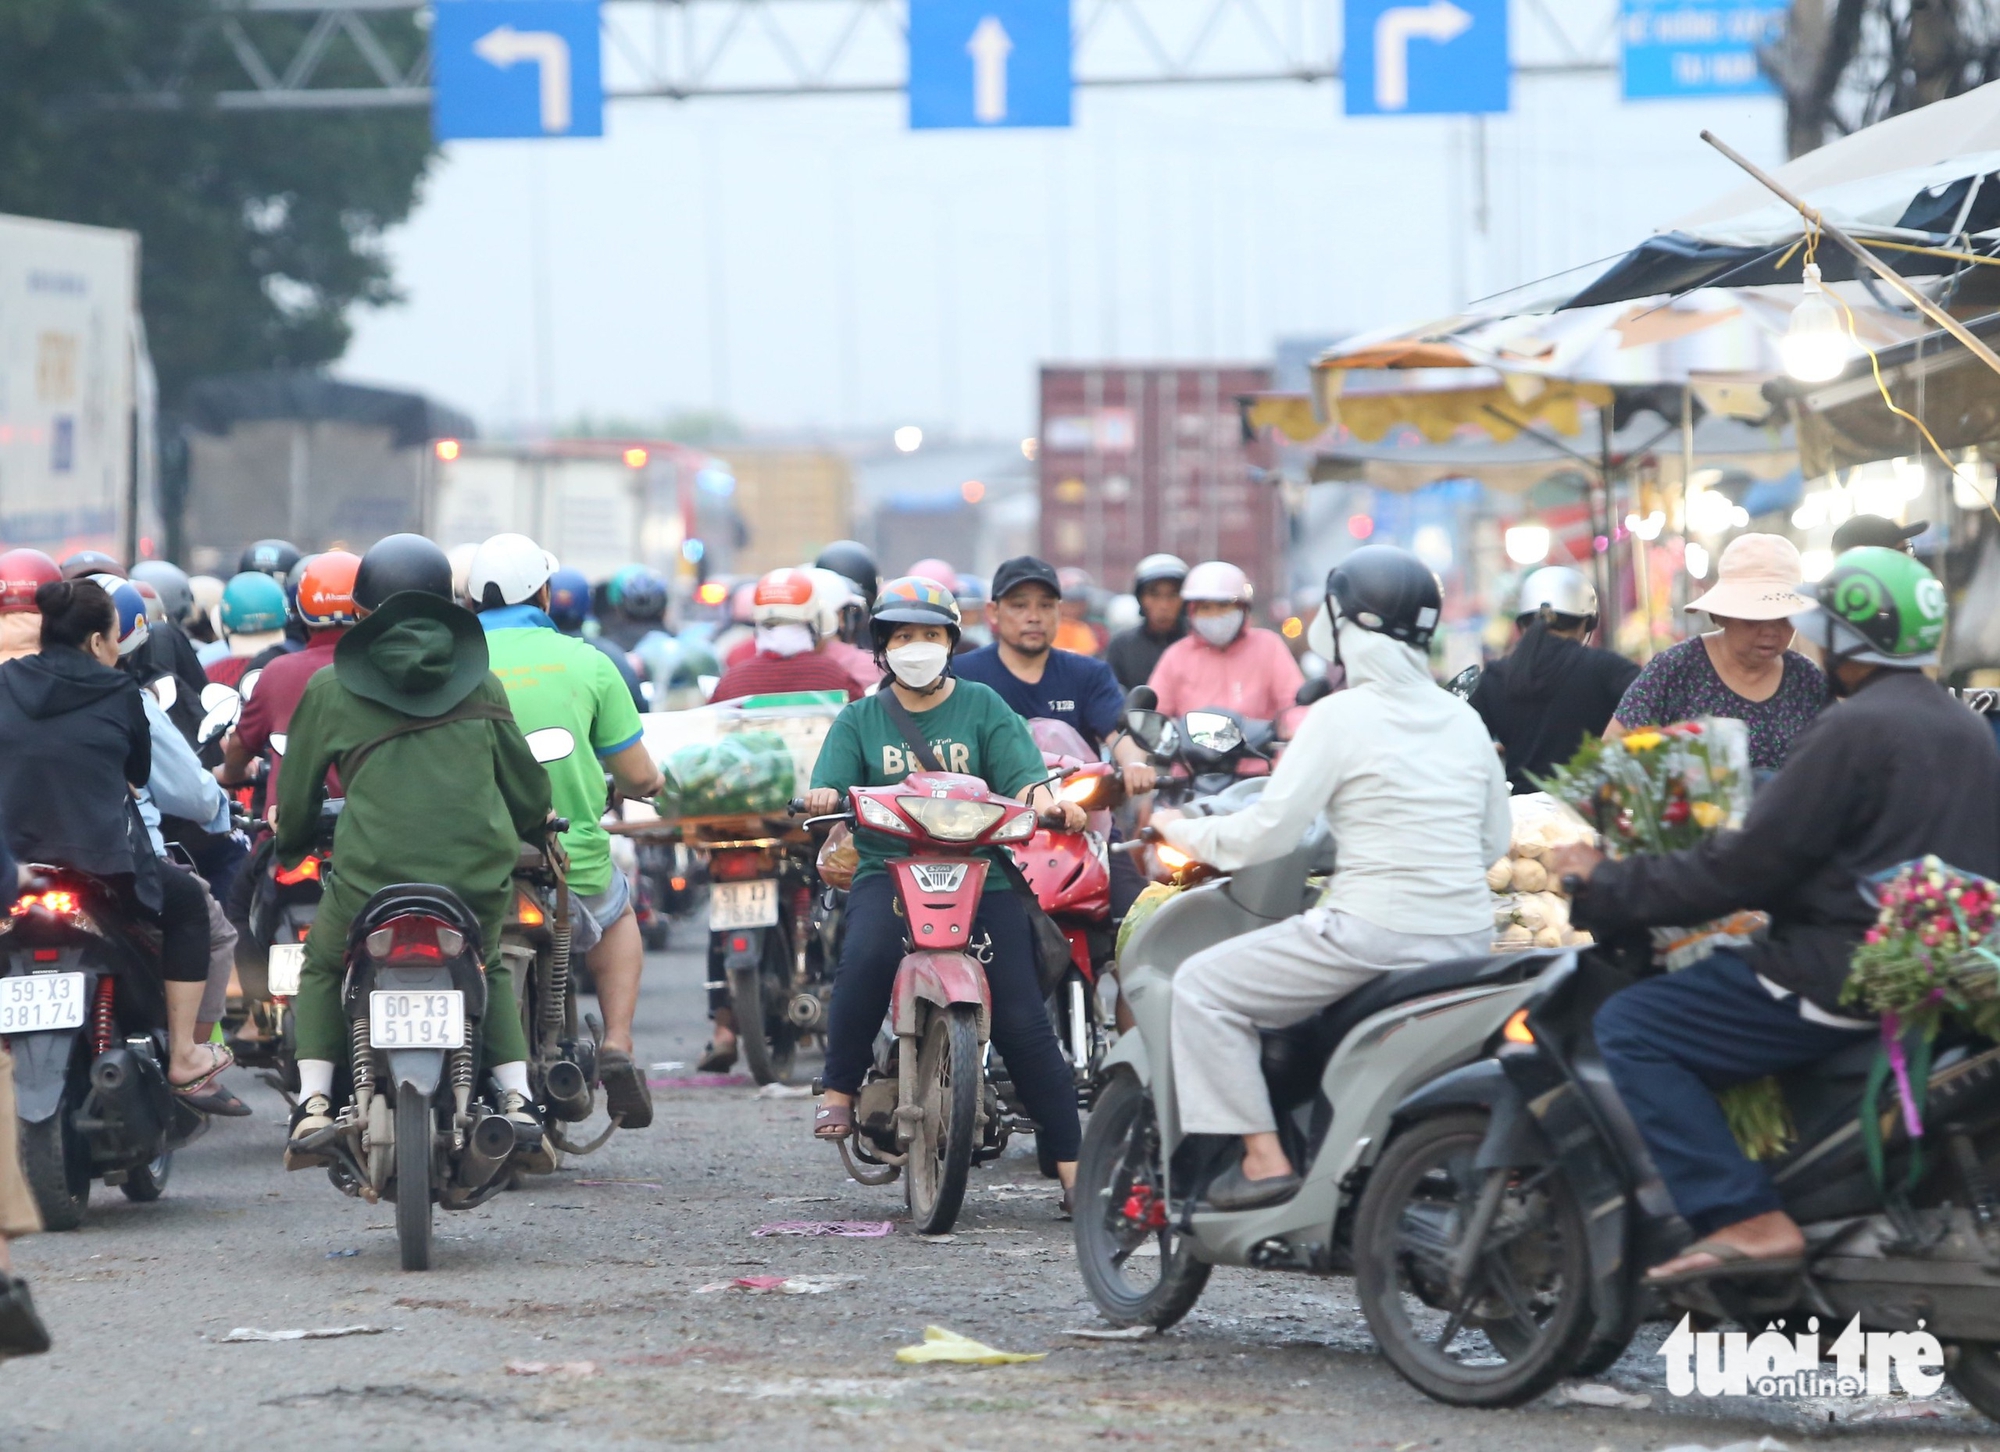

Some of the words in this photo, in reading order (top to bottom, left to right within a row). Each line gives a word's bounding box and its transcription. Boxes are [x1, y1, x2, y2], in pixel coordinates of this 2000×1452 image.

[12, 979, 70, 1002] 59-X3
[4, 1002, 77, 1027] 381.74
[385, 995, 449, 1017] 60-X3
[385, 1020, 449, 1043] 5194
